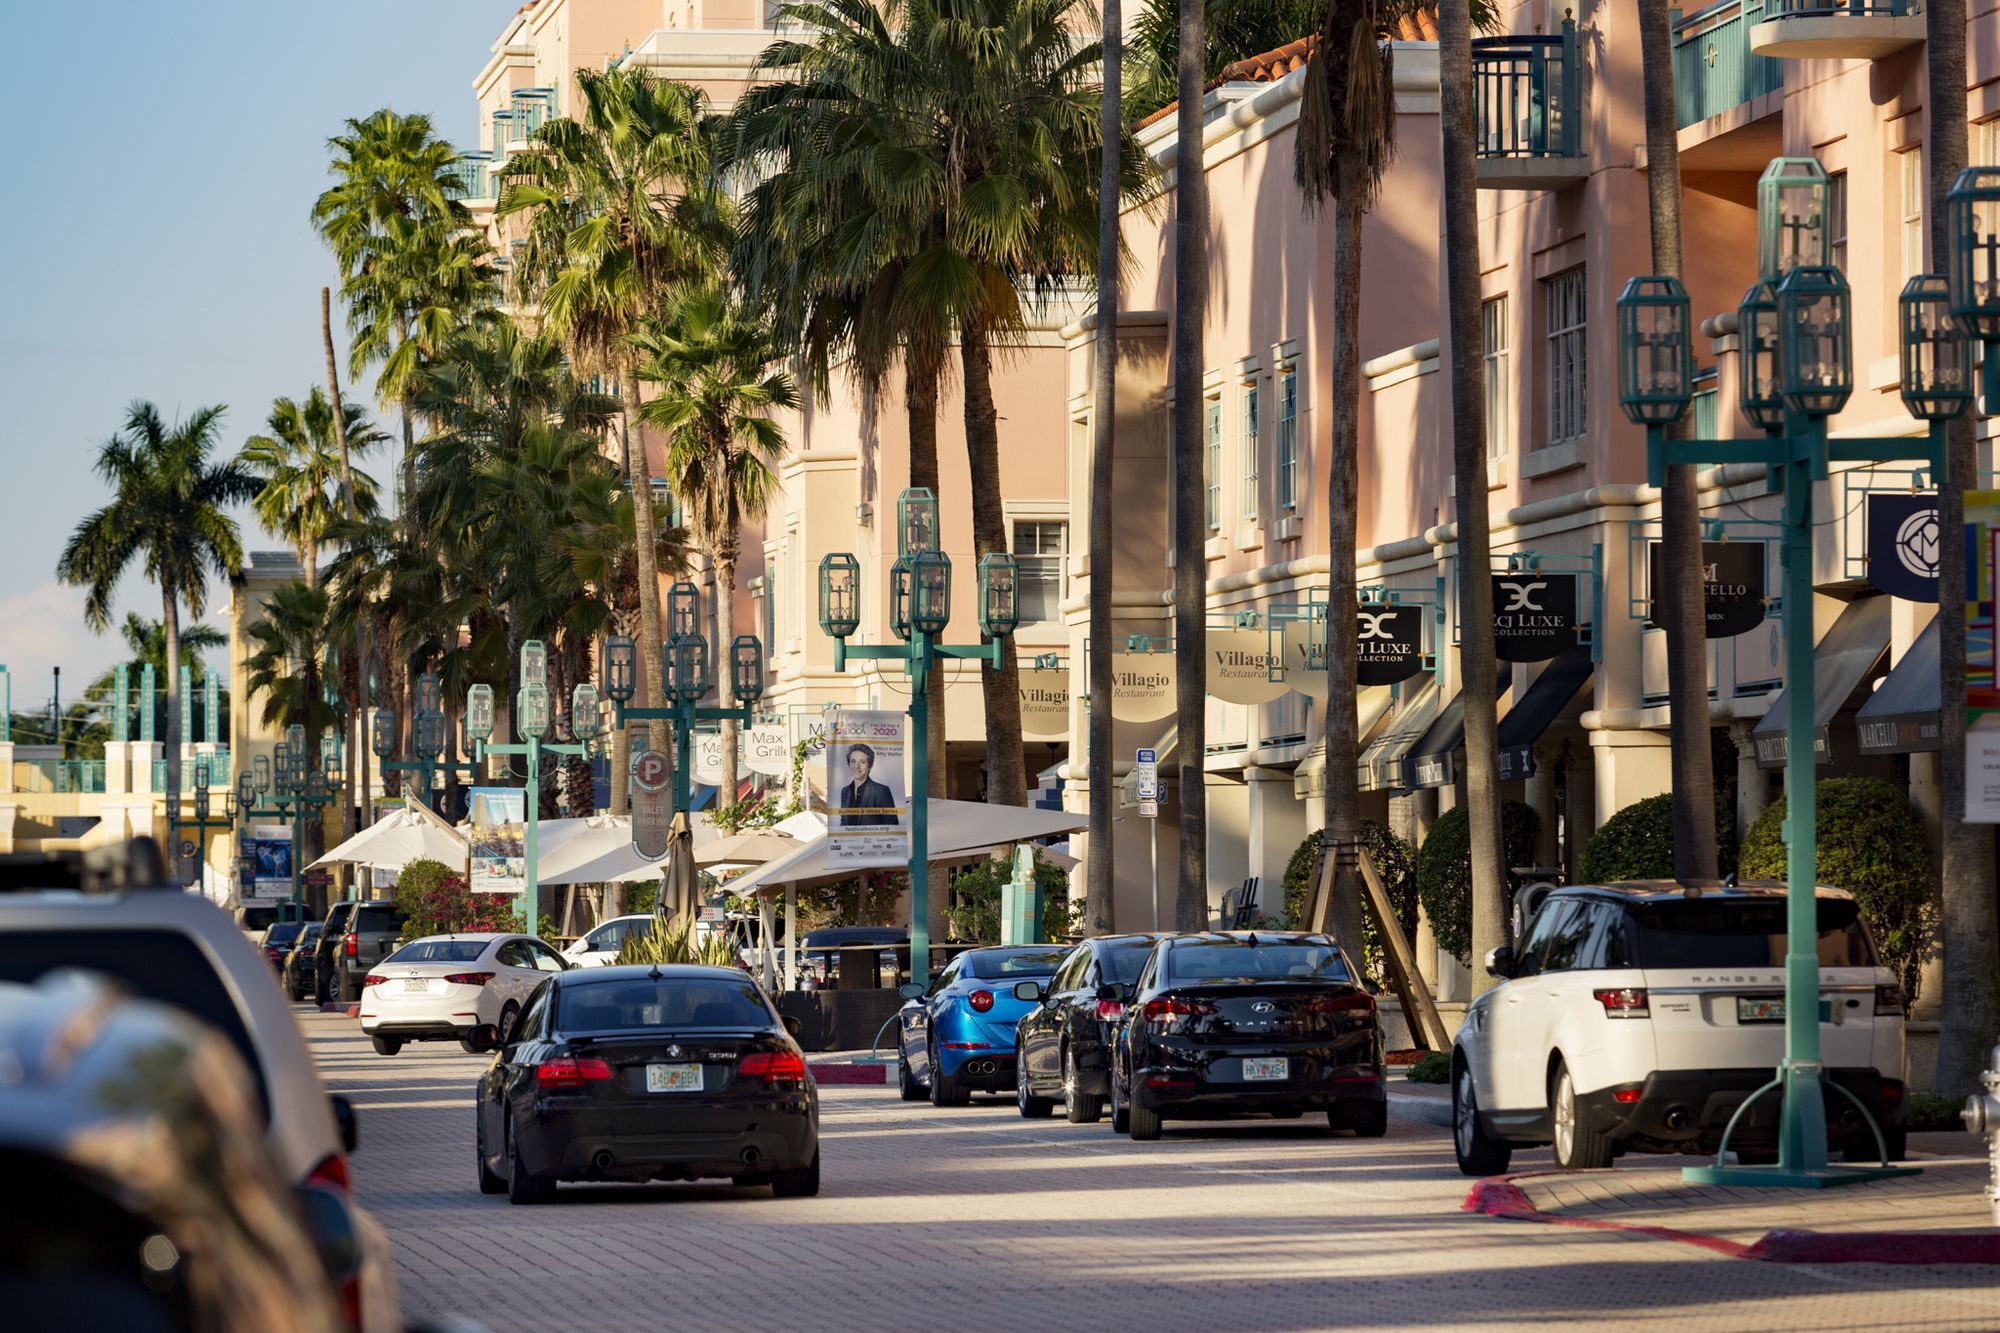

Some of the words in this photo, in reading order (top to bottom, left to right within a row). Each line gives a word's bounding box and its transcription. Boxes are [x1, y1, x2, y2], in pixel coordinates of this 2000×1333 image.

[1703, 585, 1747, 596] CELLO
[1518, 613, 1564, 627] LUXE
[1493, 628, 1556, 636] COLLECTION
[1369, 641, 1412, 655] LUXE
[1215, 650, 1280, 670] Villagio
[1112, 672, 1170, 689] Villagio
[1113, 688, 1166, 698] Restaurant
[1022, 703, 1069, 713] Restauran
[873, 728, 898, 736] 2020
[645, 760, 662, 781] P
[641, 806, 664, 815] VALET
[183, 842, 192, 853] P
